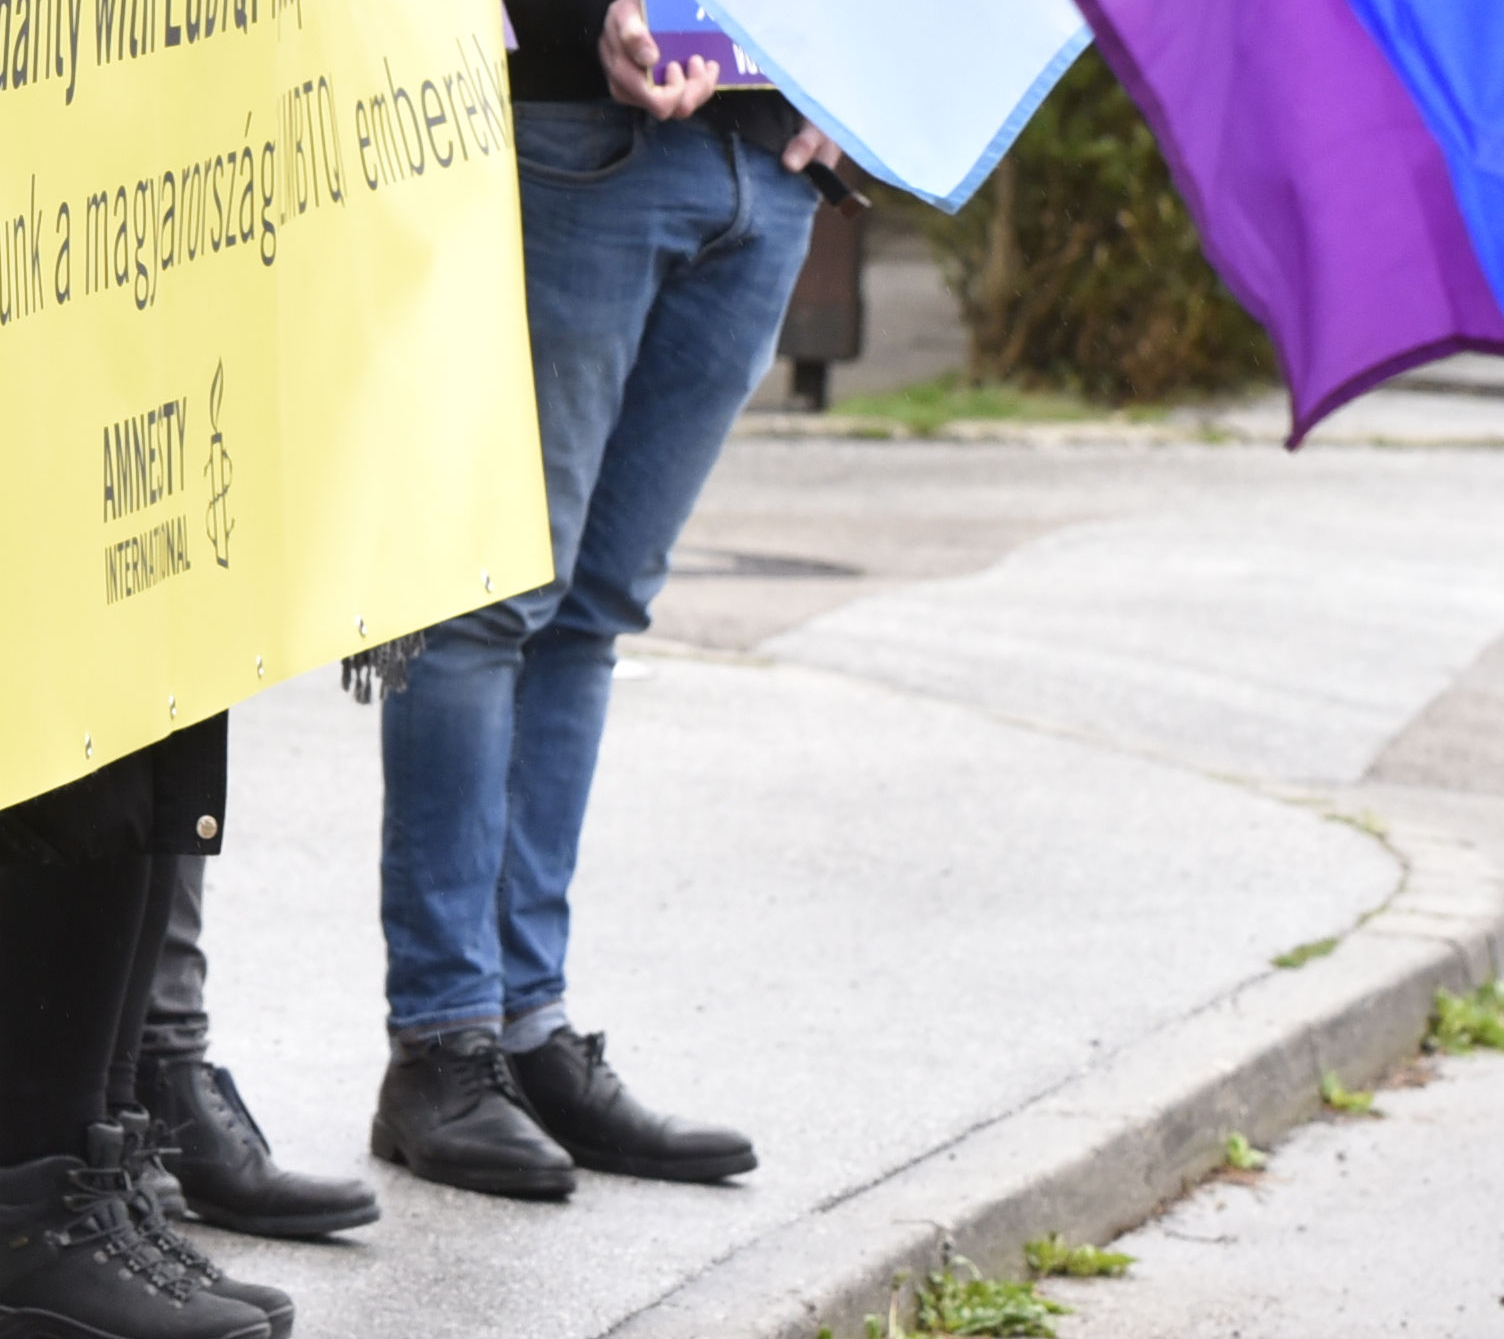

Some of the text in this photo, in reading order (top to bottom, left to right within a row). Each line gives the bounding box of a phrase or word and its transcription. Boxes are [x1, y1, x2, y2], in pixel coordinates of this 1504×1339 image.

[54, 201, 71, 305] a
[103, 396, 187, 524] AMNESTY
[104, 514, 191, 606] INTERNATIONAL
